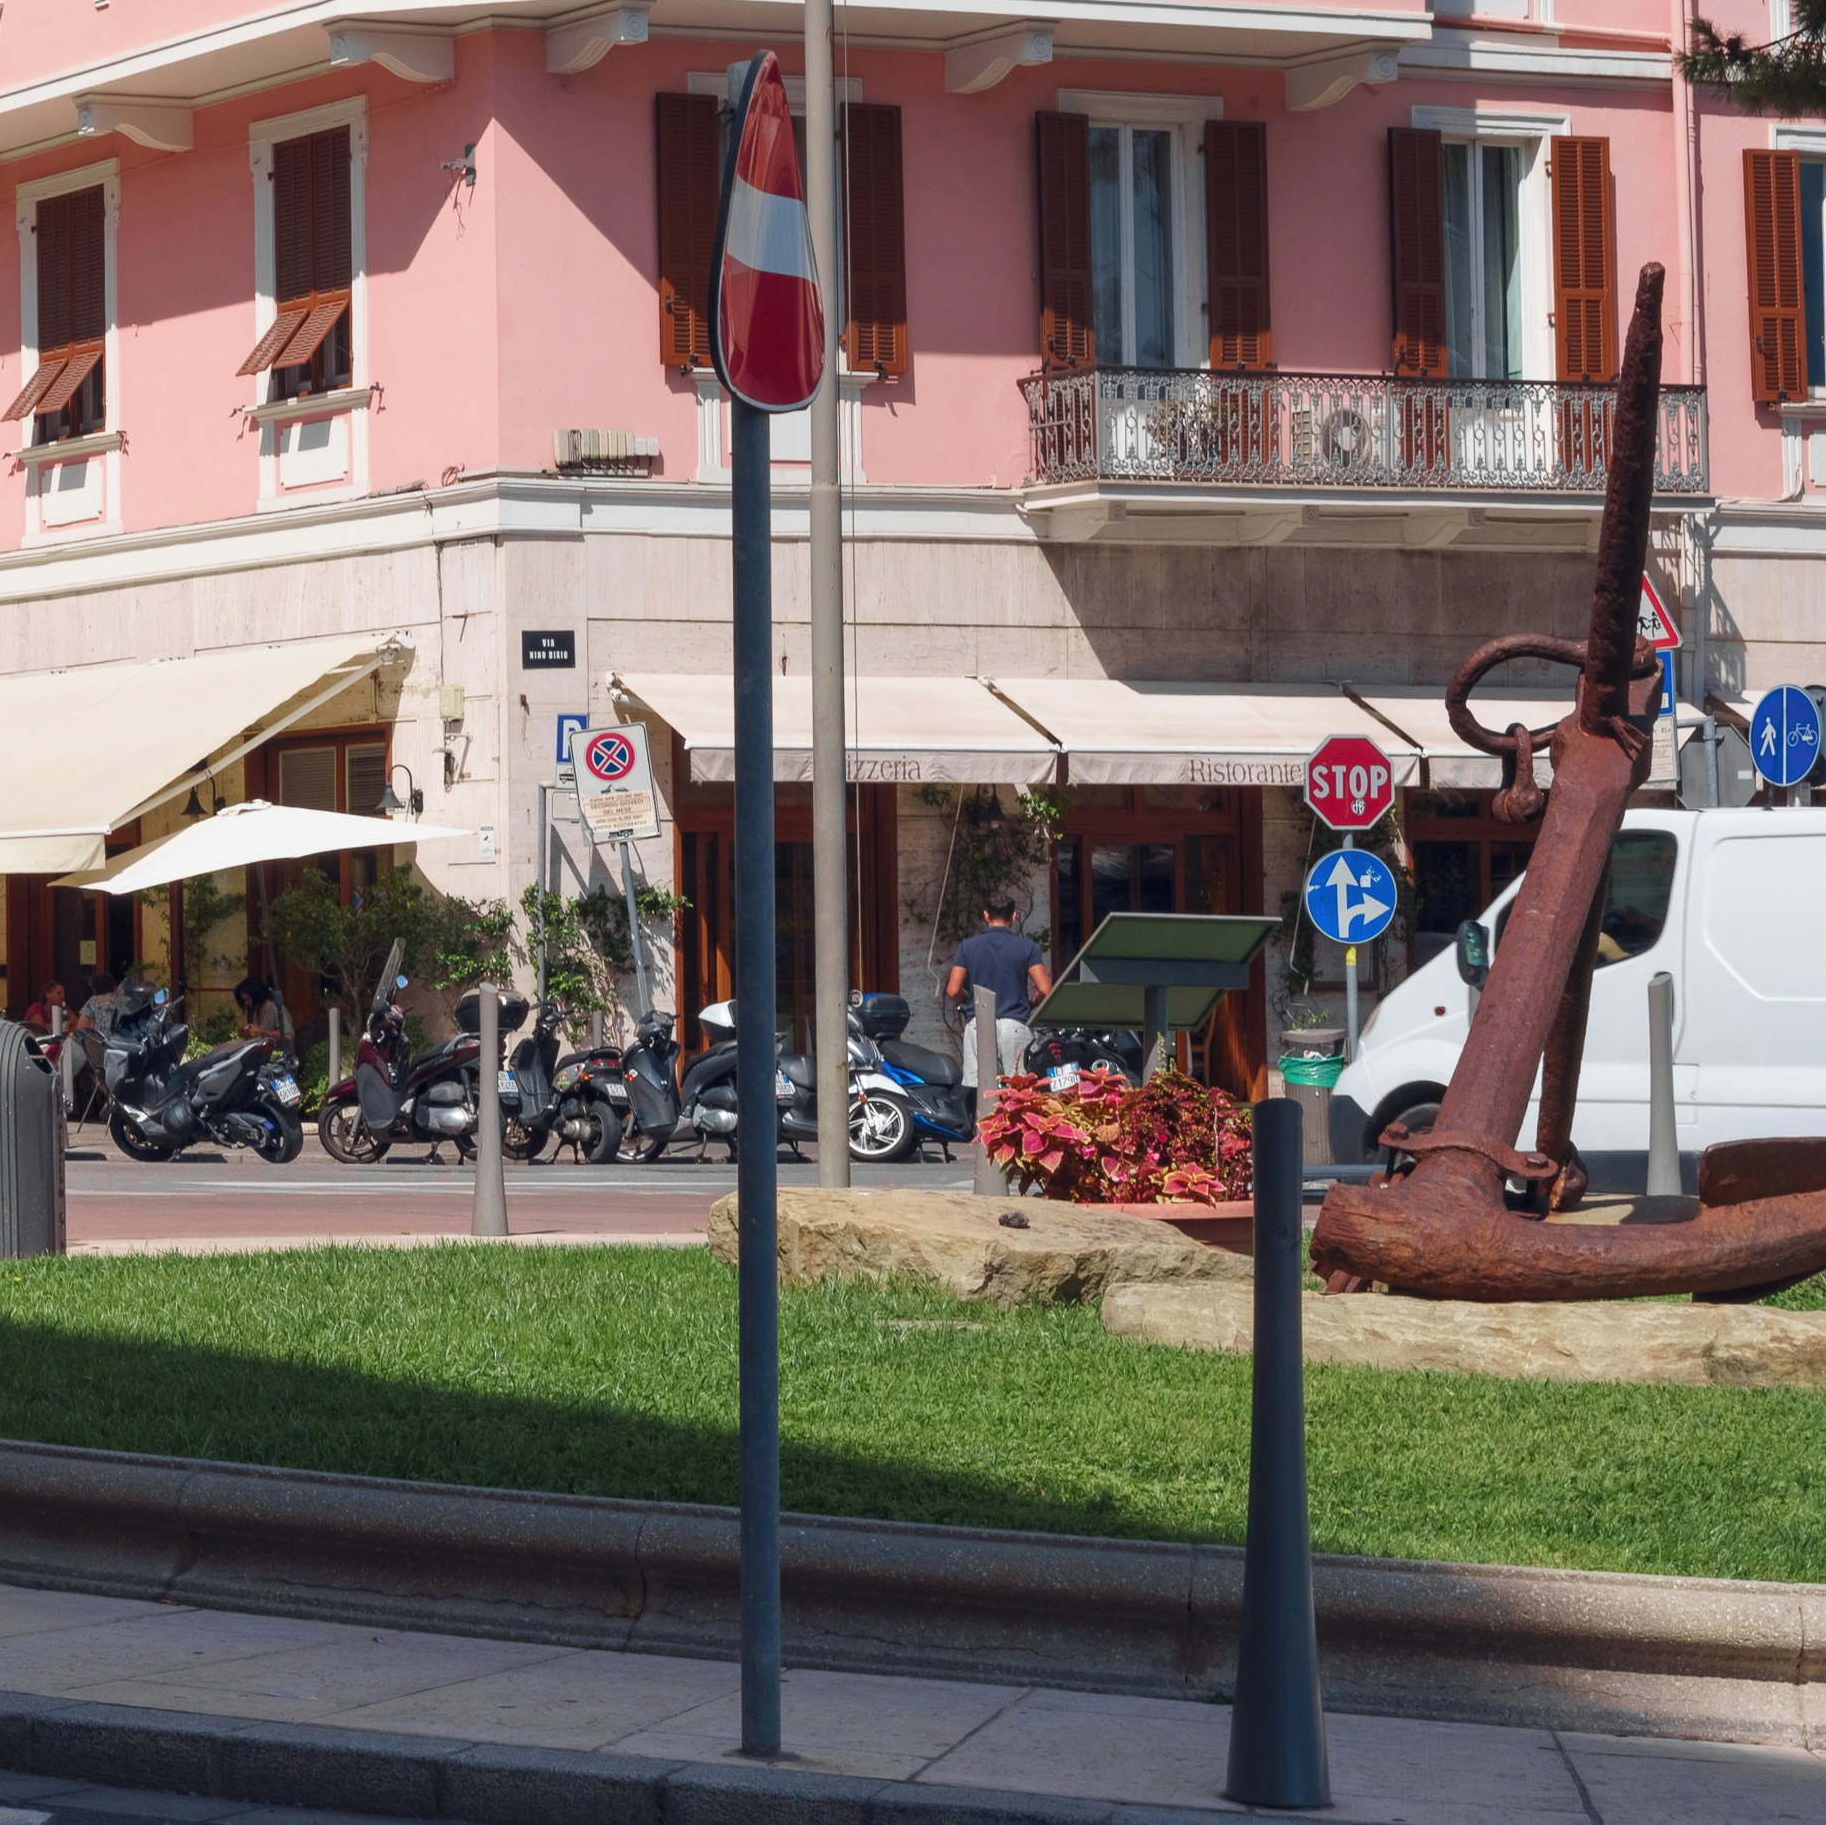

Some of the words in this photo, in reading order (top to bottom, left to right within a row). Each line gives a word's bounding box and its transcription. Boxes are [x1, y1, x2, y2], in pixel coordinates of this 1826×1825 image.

[541, 638, 555, 647] VIA
[529, 650, 546, 660] NINO
[548, 650, 568, 660] BIXIO
[846, 756, 922, 781] izzeria
[1189, 758, 1303, 784] Ristorante
[1312, 765, 1388, 799] STOP
[590, 802, 619, 810] SECONDO
